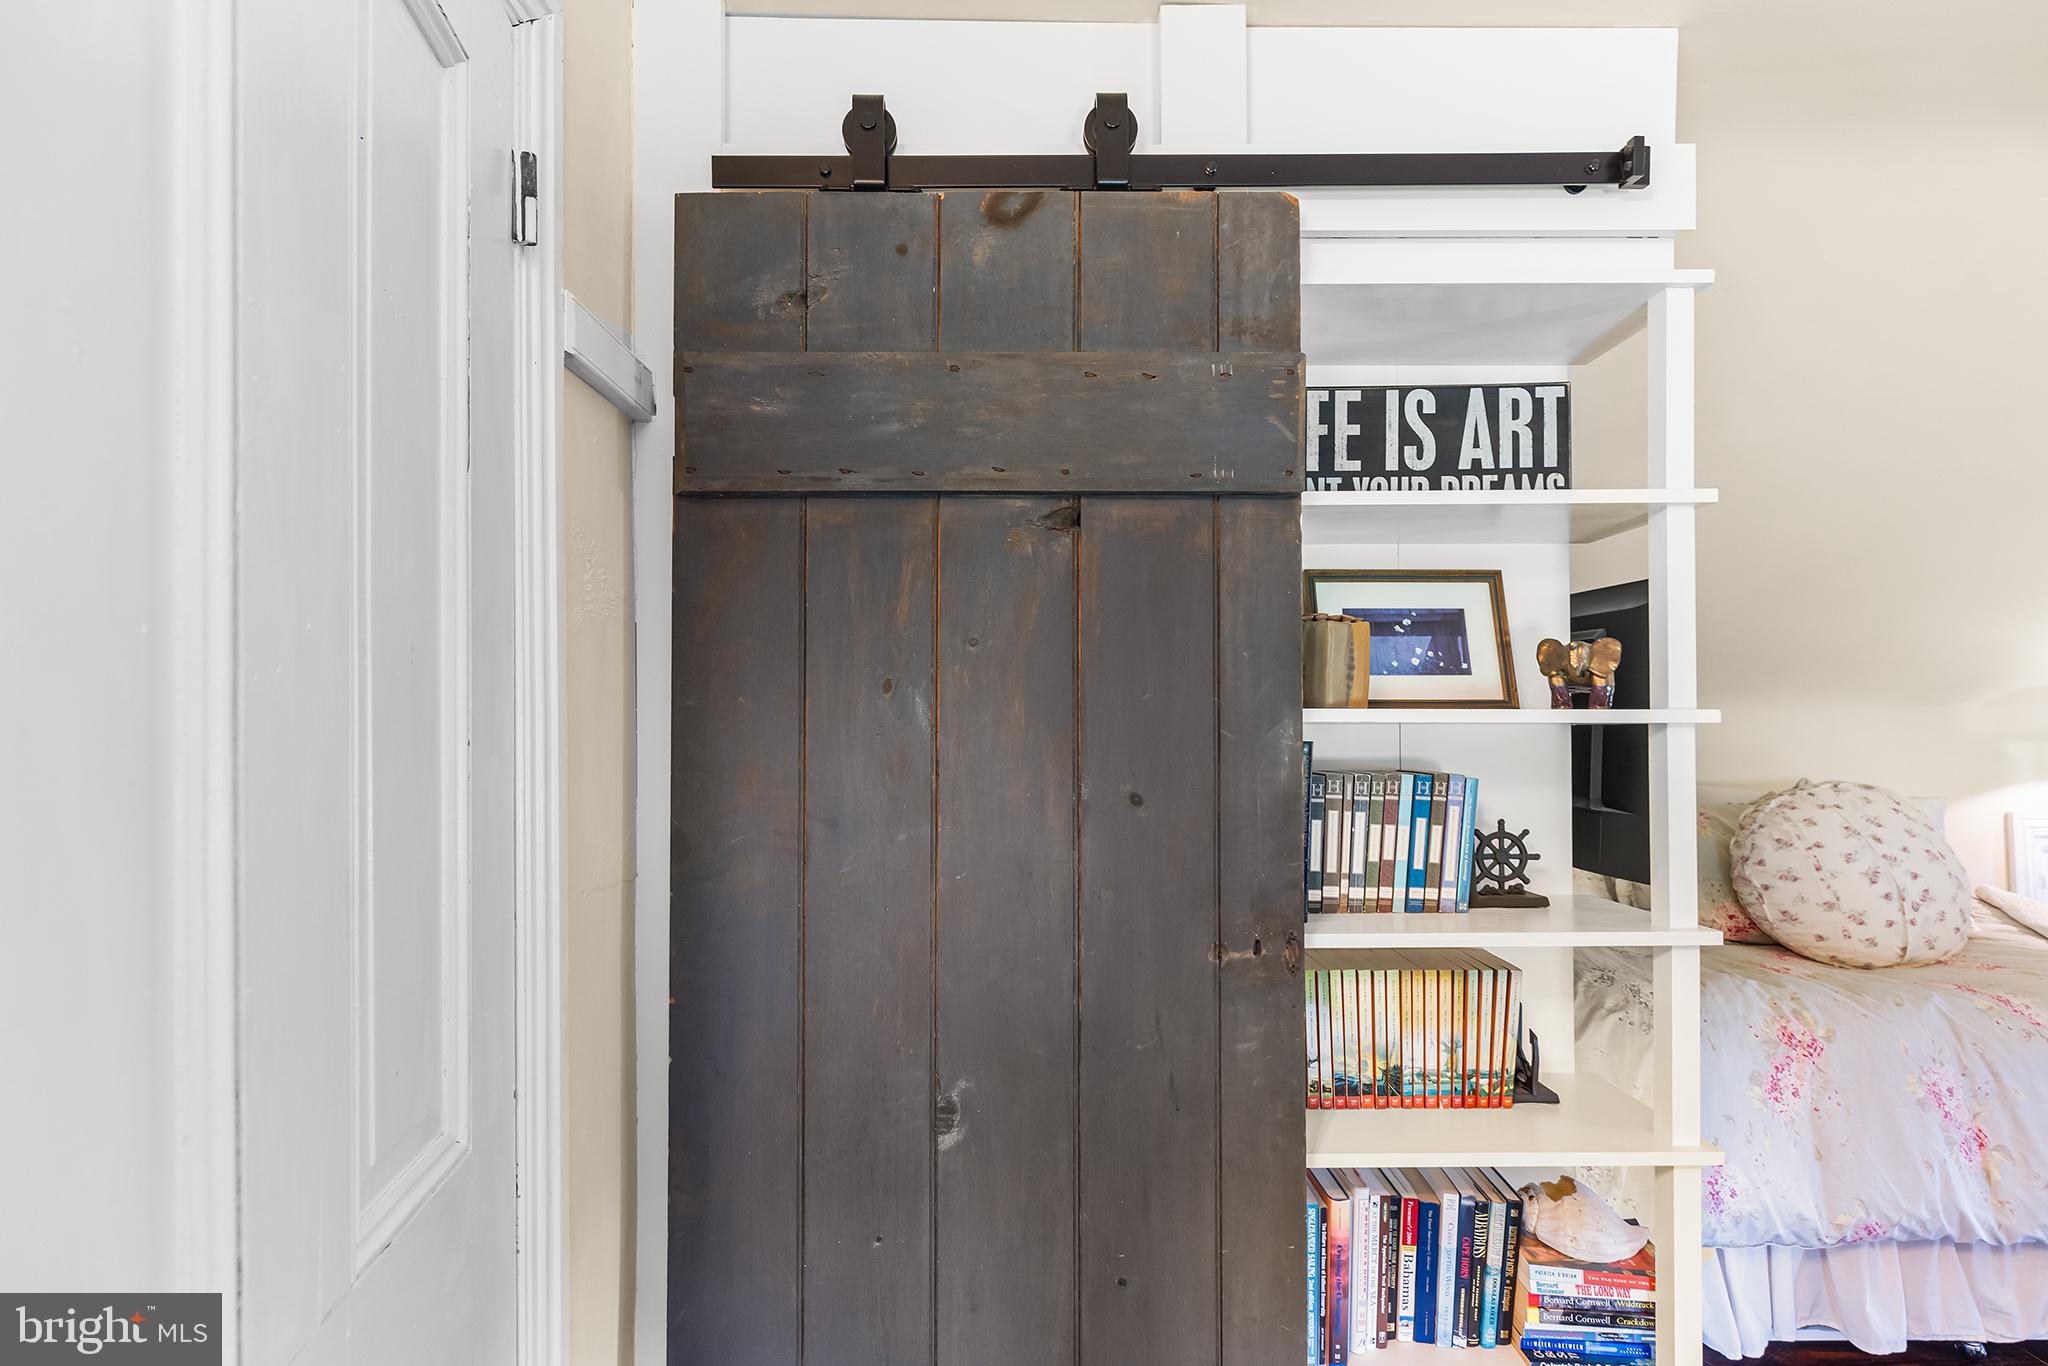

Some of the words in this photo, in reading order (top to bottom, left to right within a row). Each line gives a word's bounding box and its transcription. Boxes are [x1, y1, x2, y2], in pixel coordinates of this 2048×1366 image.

[1307, 390, 1361, 471] FE
[1385, 389, 1436, 471] IS
[1458, 386, 1566, 470] ART
[1473, 1210, 1488, 1259] ALBATROSS
[1462, 1236, 1471, 1256] CAPE
[1460, 1257, 1470, 1279] HORN
[1402, 1254, 1414, 1311] Bahamas
[1536, 1281, 1559, 1289] Bernard
[1369, 1290, 1377, 1306] SEA
[1490, 1277, 1498, 1305] DOUGLAS
[1575, 1284, 1592, 1296] THE
[1593, 1286, 1614, 1297] LONG
[1616, 1287, 1631, 1298] WAY
[1543, 1296, 1574, 1305] Bernard
[1575, 1297, 1611, 1307] Cornwell
[1616, 1299, 1654, 1309] Wildtrack
[1543, 1312, 1574, 1322] Bernard
[1575, 1314, 1611, 1325] Cornwell
[1616, 1317, 1655, 1327] Crackdow
